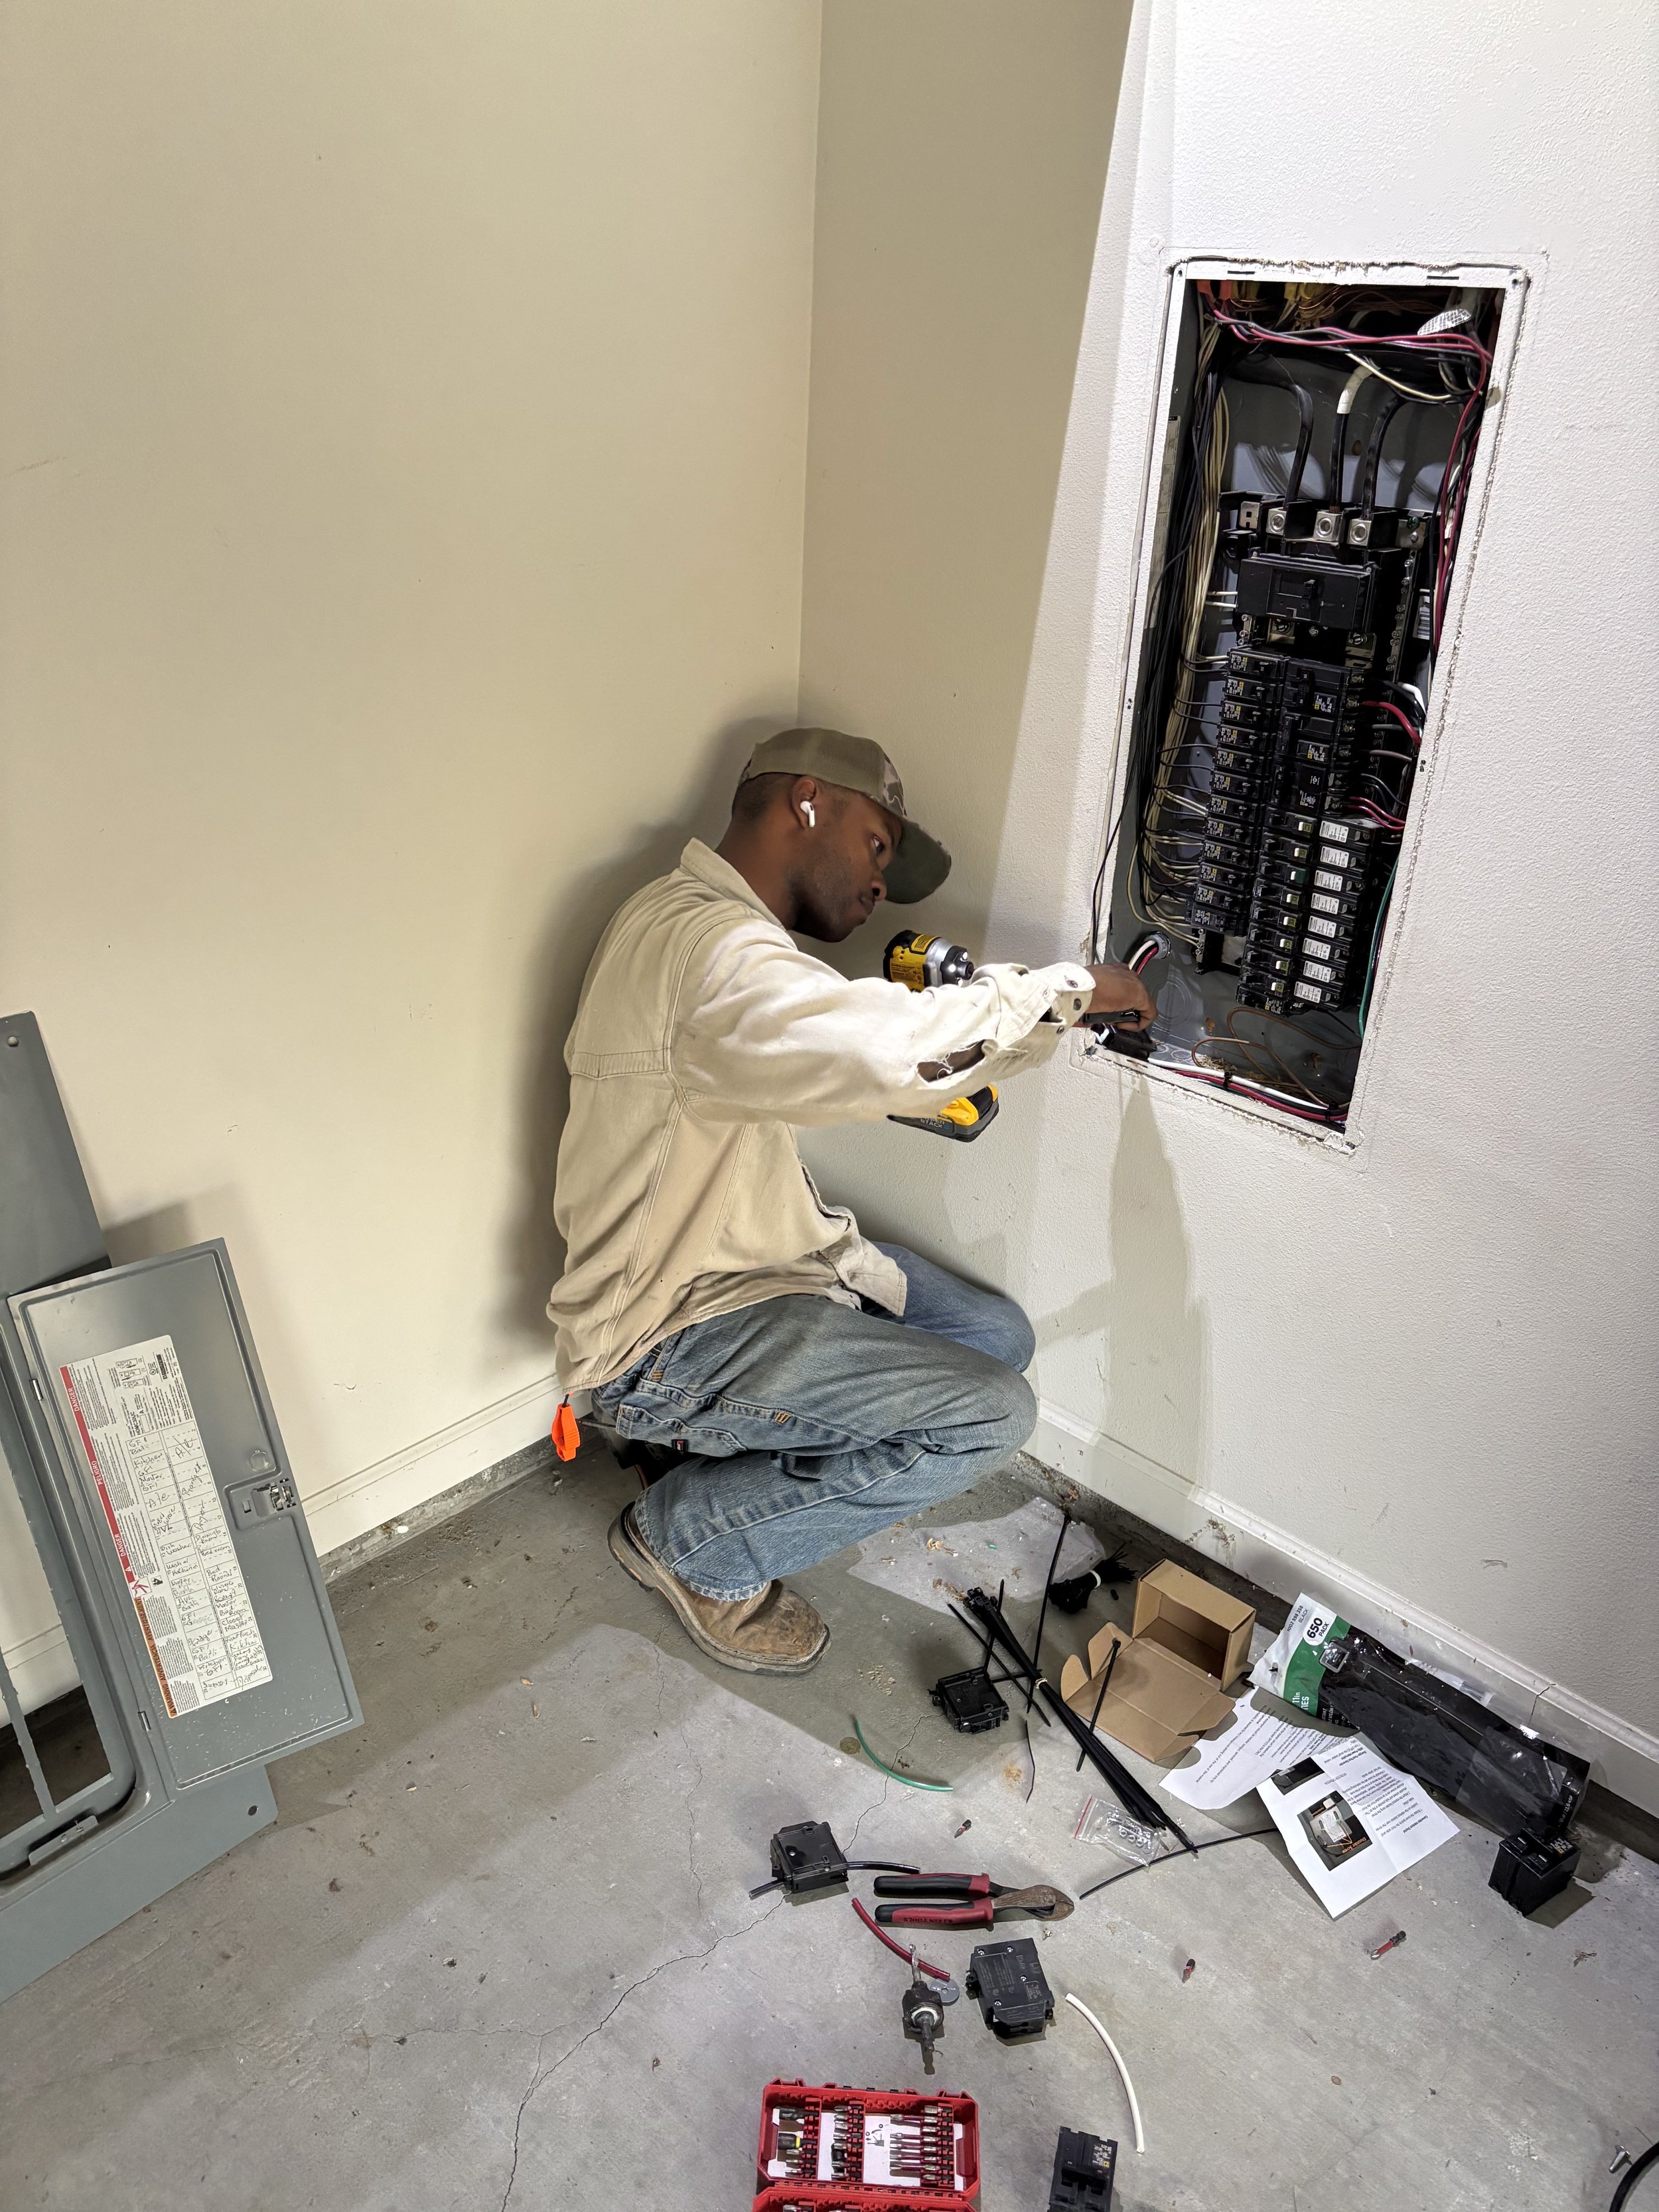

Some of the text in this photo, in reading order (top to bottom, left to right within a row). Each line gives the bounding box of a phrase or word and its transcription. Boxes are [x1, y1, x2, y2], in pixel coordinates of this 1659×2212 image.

[68, 1387, 80, 1412] DANGER
[92, 1461, 103, 1485] PELIGRO
[114, 1534, 126, 1557] DANGER
[1298, 1608, 1309, 1623] BLACK
[1307, 1617, 1323, 1638] 650
[1319, 1622, 1329, 1637] PACK
[149, 1644, 167, 1680] ADVERTENCIA
[162, 1684, 175, 1709] WARNING
[1341, 1836, 1366, 1854] Shoulder Screw
